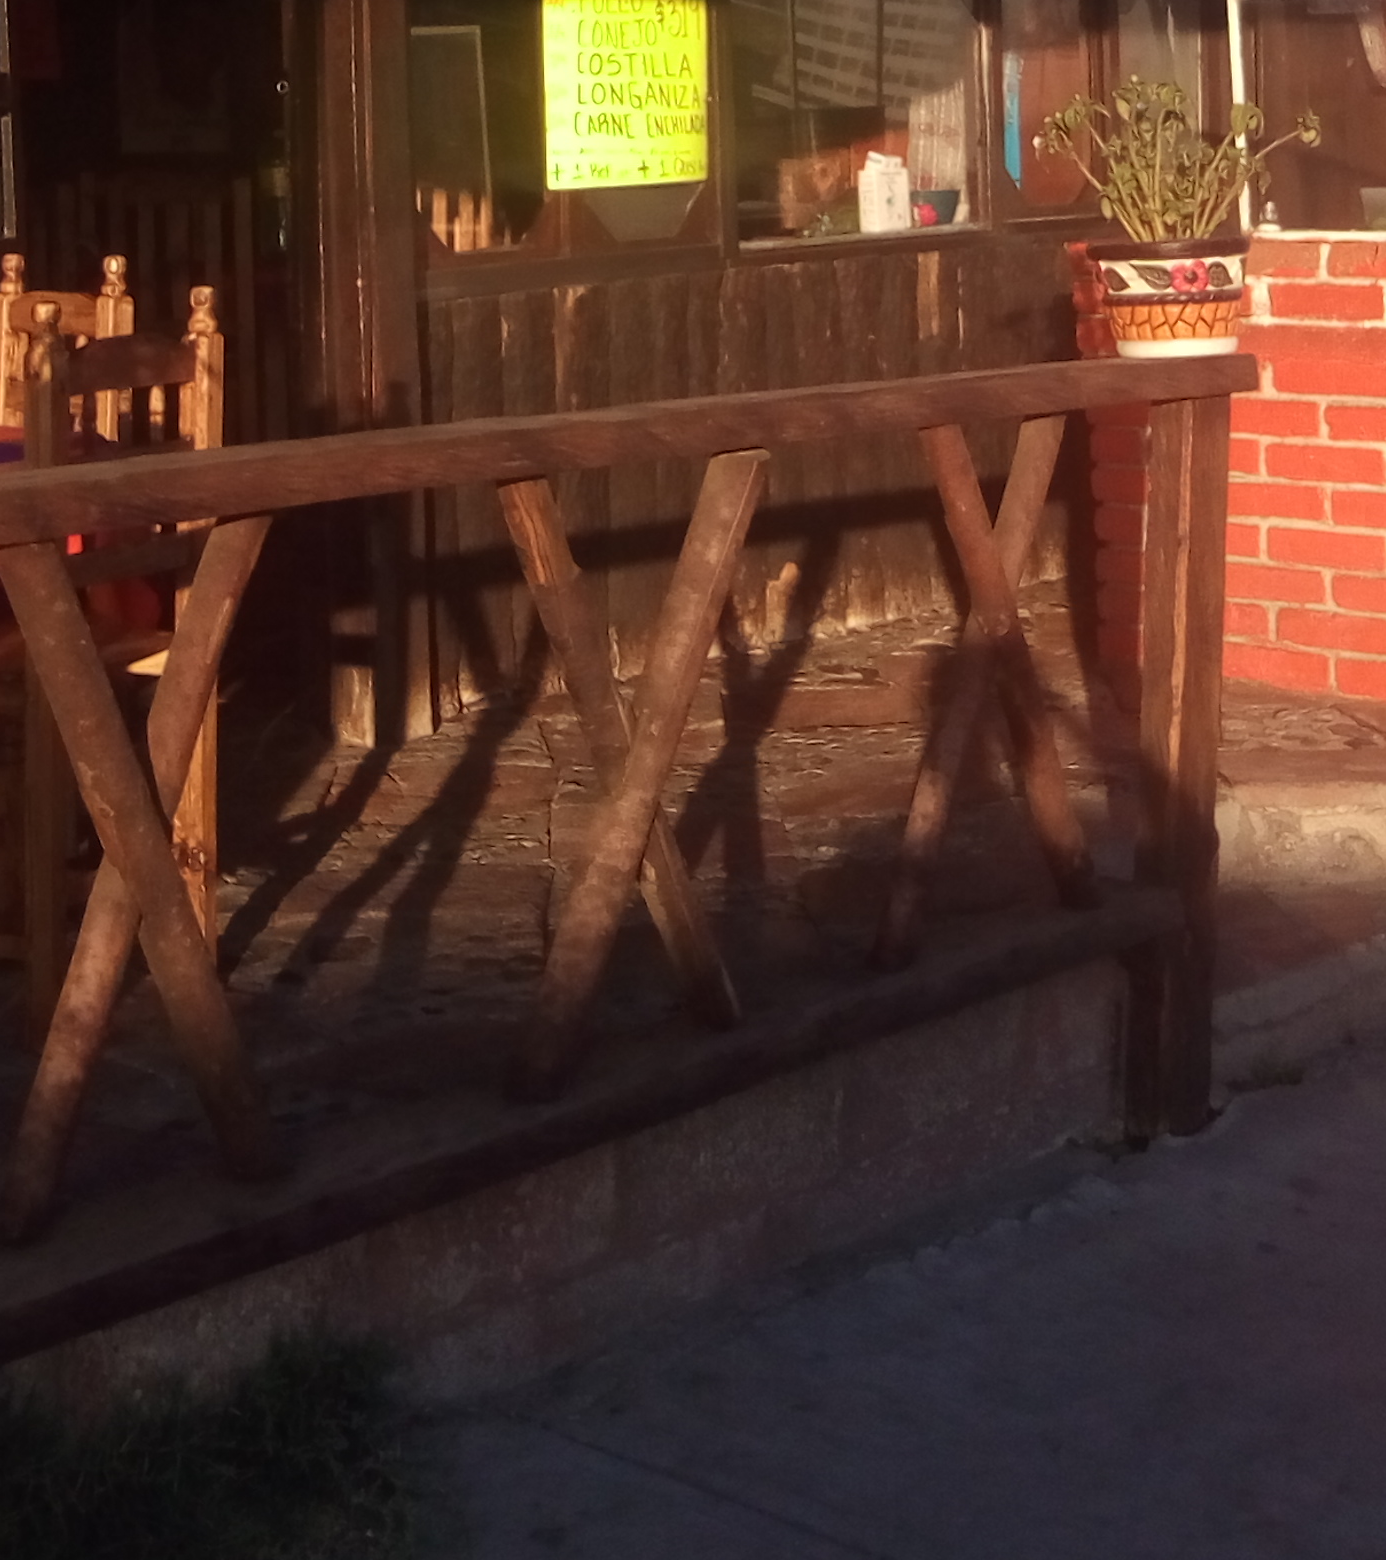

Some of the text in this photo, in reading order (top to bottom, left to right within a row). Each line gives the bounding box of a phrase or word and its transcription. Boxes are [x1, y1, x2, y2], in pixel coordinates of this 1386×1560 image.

[577, 18, 659, 51] CONEJO
[577, 51, 694, 80] COSTILLA
[577, 81, 703, 112] LONGANIZA
[574, 110, 636, 140] CARNE
